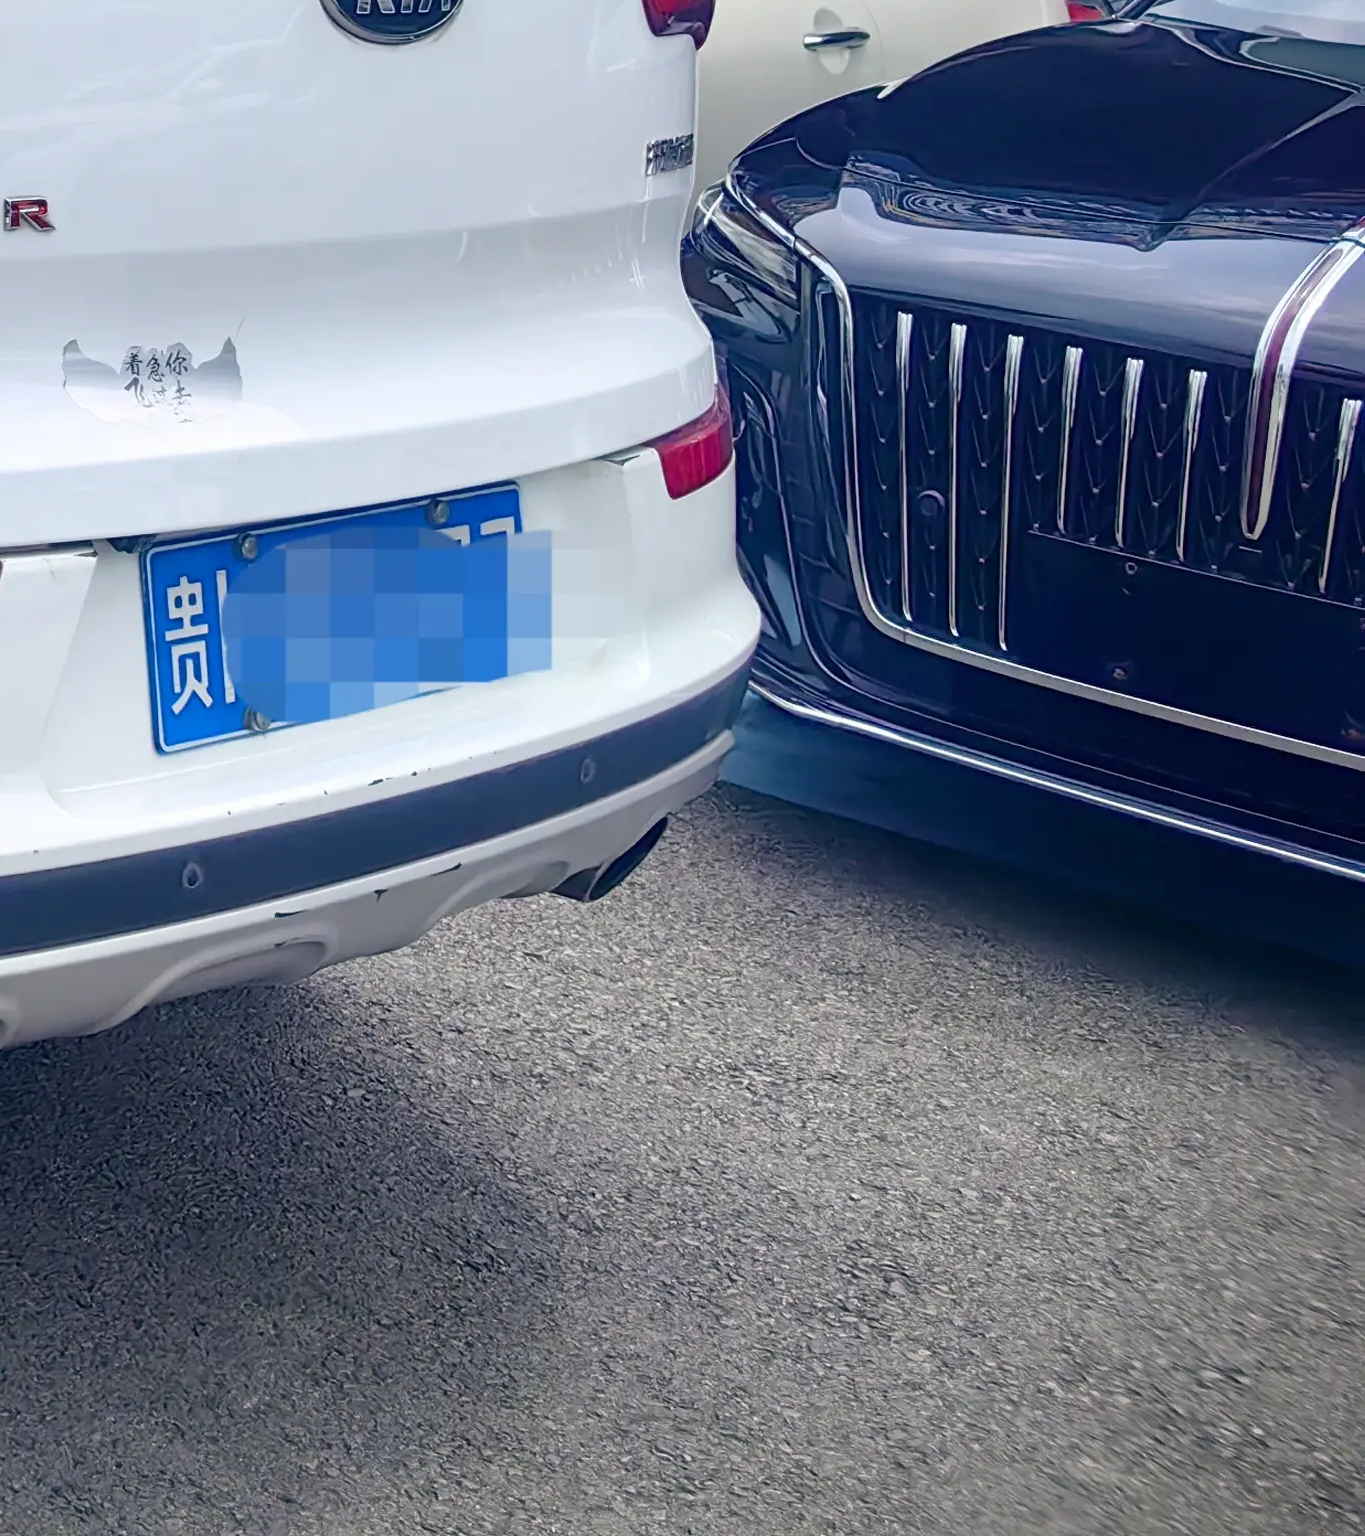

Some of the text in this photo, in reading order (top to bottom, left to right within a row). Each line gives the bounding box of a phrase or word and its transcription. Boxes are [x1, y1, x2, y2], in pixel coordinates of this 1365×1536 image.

[3, 195, 57, 233] R
[124, 348, 189, 383] 着急你
